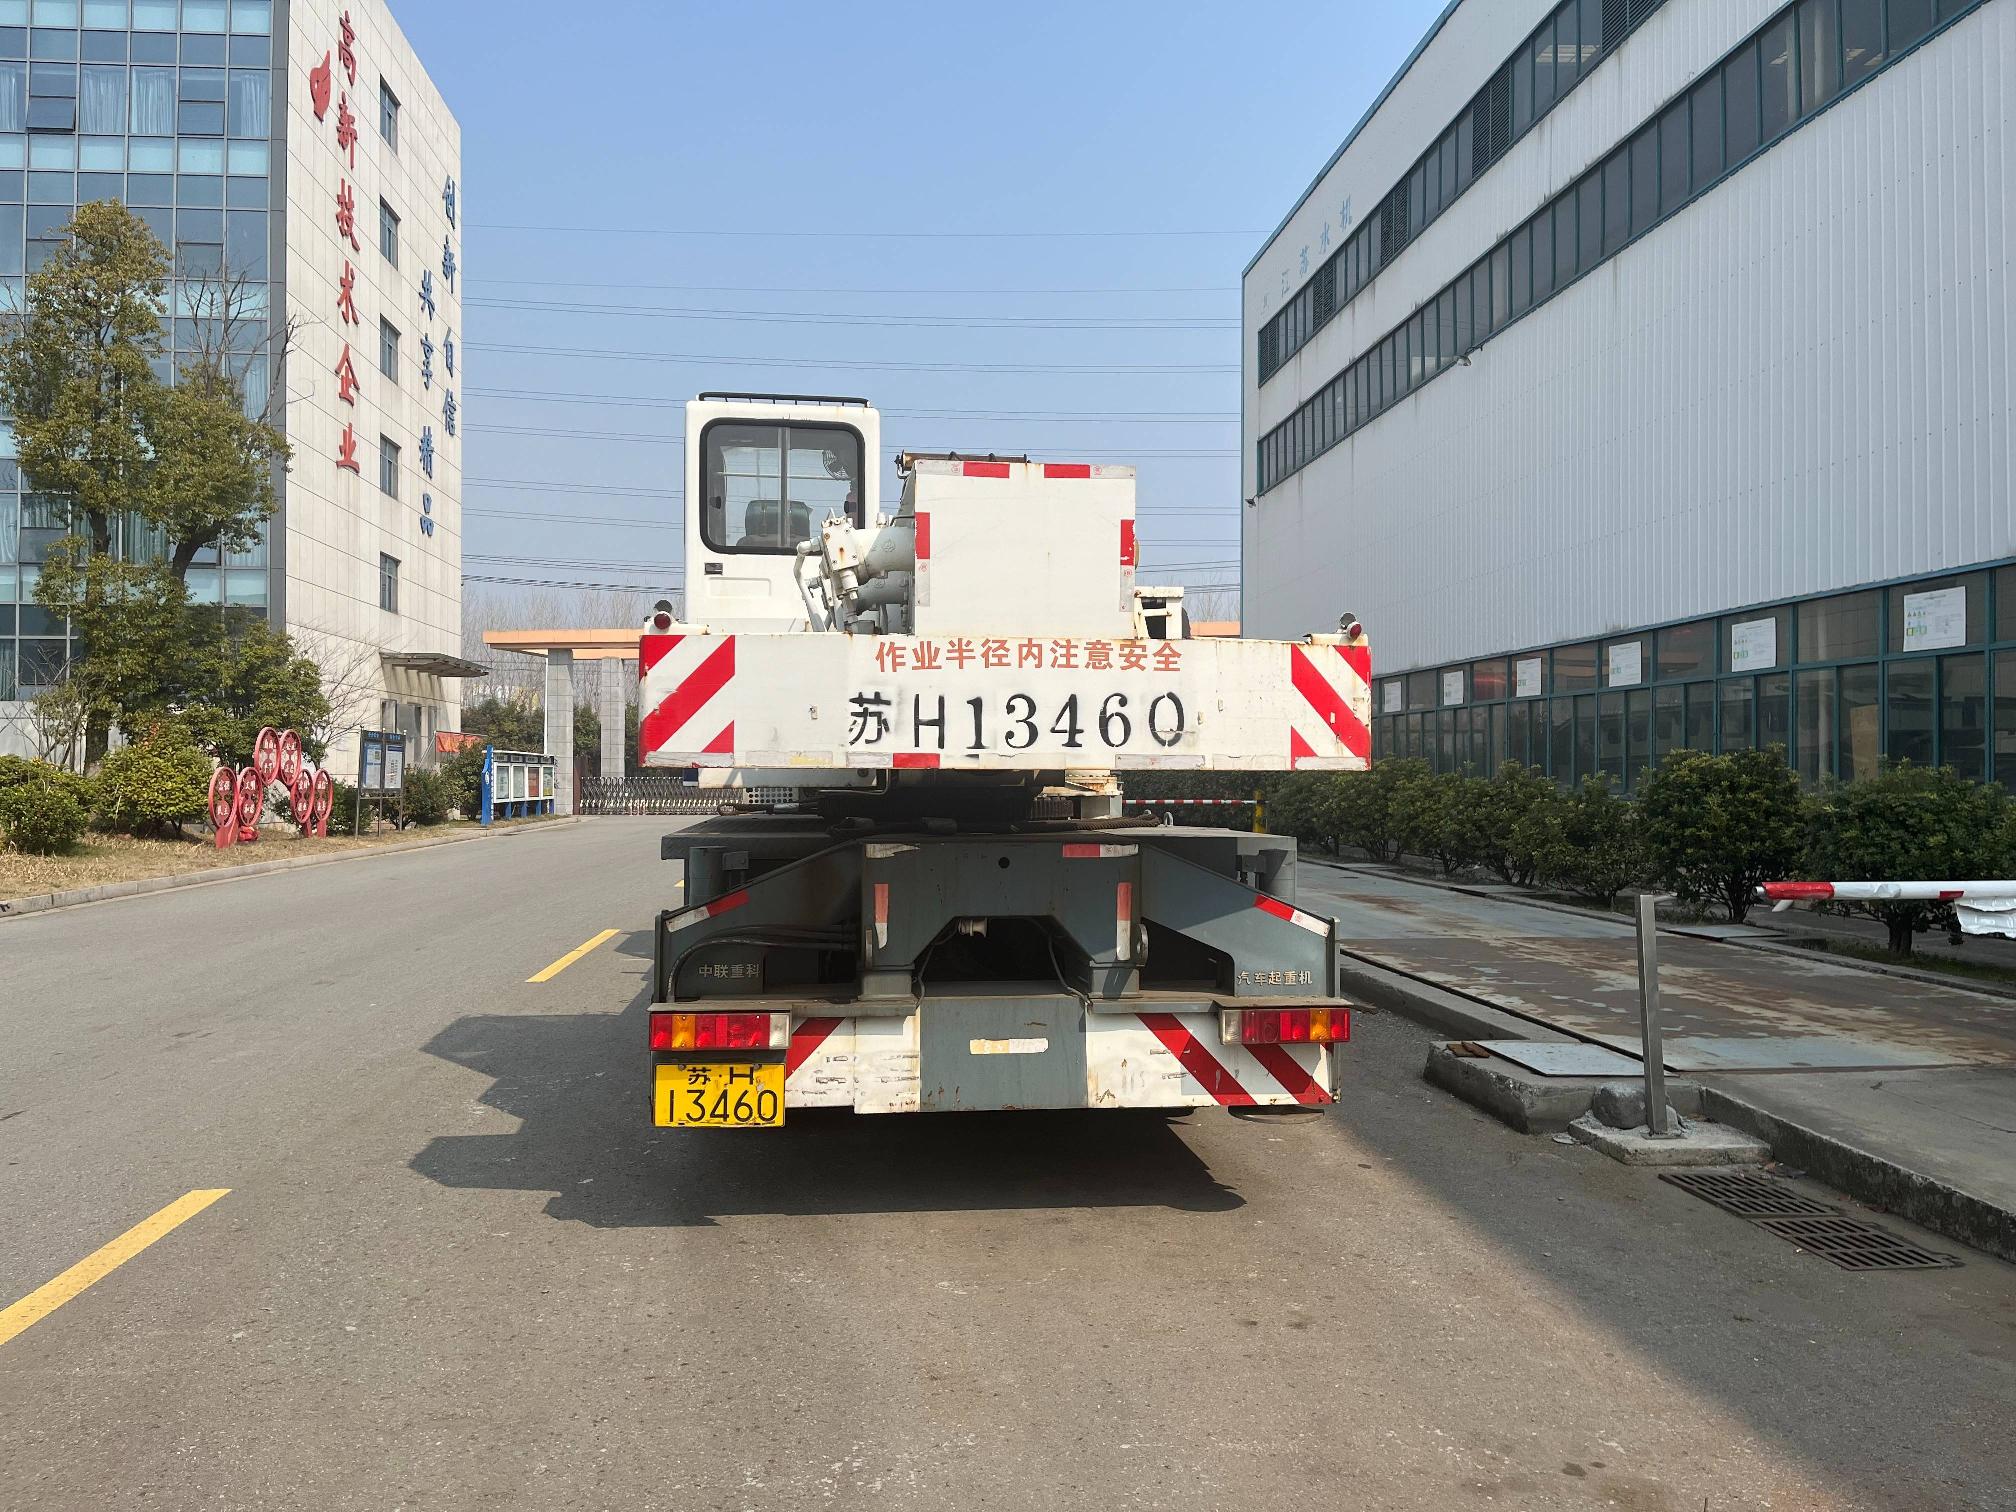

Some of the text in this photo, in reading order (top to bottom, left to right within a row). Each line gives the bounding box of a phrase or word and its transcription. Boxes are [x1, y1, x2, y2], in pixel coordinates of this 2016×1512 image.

[335, 10, 361, 475] 高新技术企业
[875, 638, 1183, 673] 作业半径内注意安全
[698, 963, 760, 979] 中联重科
[1237, 970, 1313, 986] 汽车起重机
[669, 1089, 778, 1123] 13460
